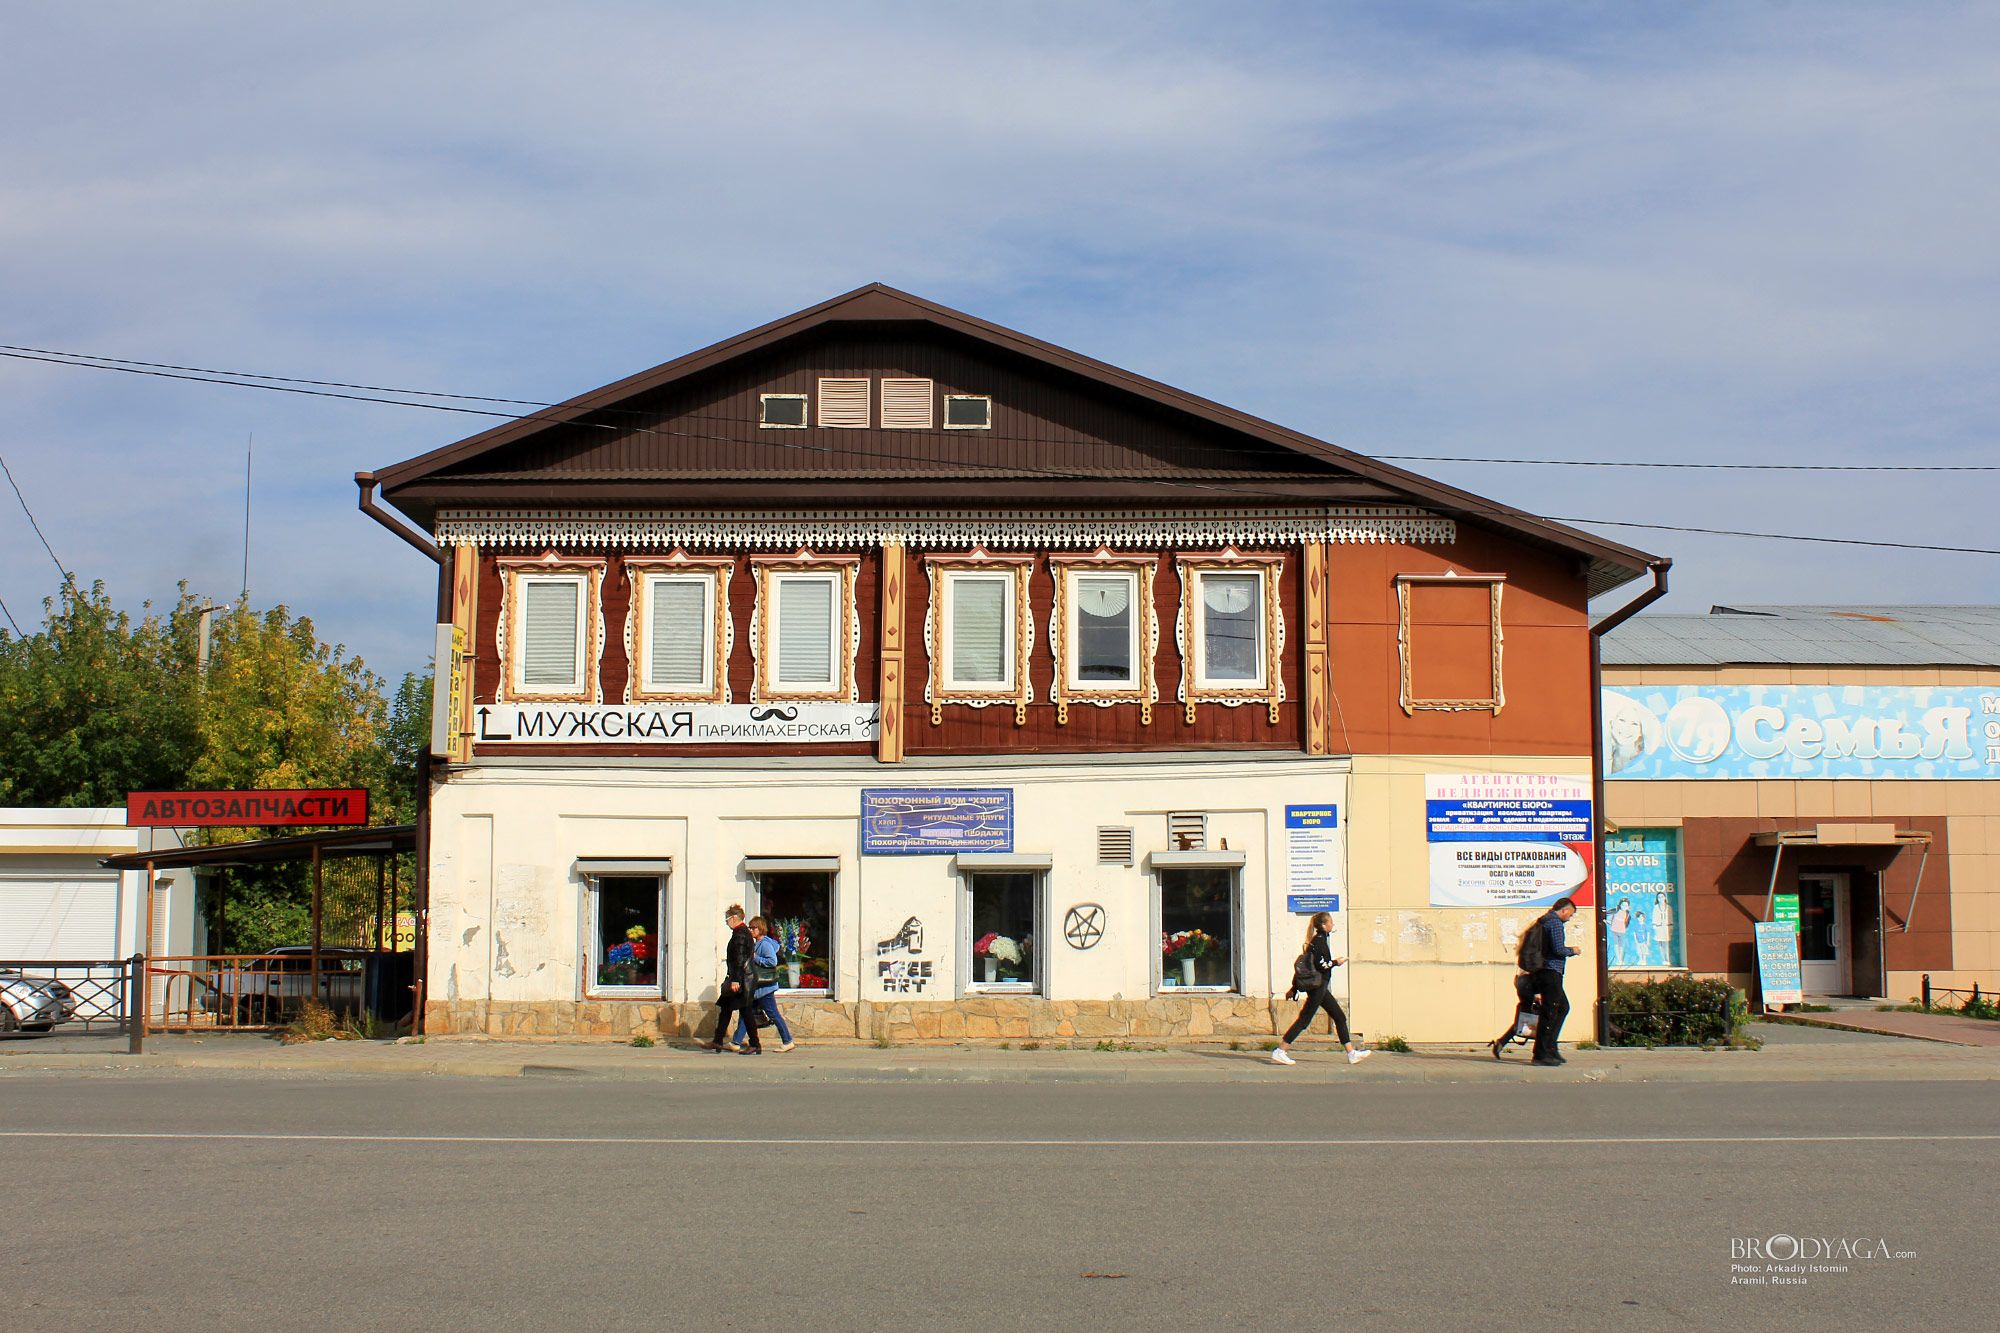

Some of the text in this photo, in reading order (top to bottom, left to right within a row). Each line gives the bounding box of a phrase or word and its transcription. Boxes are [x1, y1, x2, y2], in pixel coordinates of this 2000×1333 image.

[517, 711, 851, 738] МУЖСКАЯ ПАРИКМАХЕРСКАЯ
[1735, 705, 1973, 760] СемьЯ
[1460, 775, 1558, 785] АГЕНТСТВО
[1437, 788, 1581, 798] НЕДВИЖИМОСТИ
[870, 796, 942, 805] ПОХОРОННЫЙ
[943, 797, 966, 805] ДОМ
[1462, 801, 1553, 809] «КВАРТИРНОЕ БЮРО»
[142, 797, 349, 819] АВТОЗАПЧАСТИ
[1558, 832, 1585, 841] 1этаж
[1456, 851, 1567, 862] ВСЕ ВИДЫ СТРАХОВАНИЯ
[1615, 855, 1660, 867] ОБУВЬ
[1760, 952, 1796, 961] ОДЕЖДЫ
[1771, 962, 1797, 970] ОБУВИ
[884, 978, 927, 992] ART
